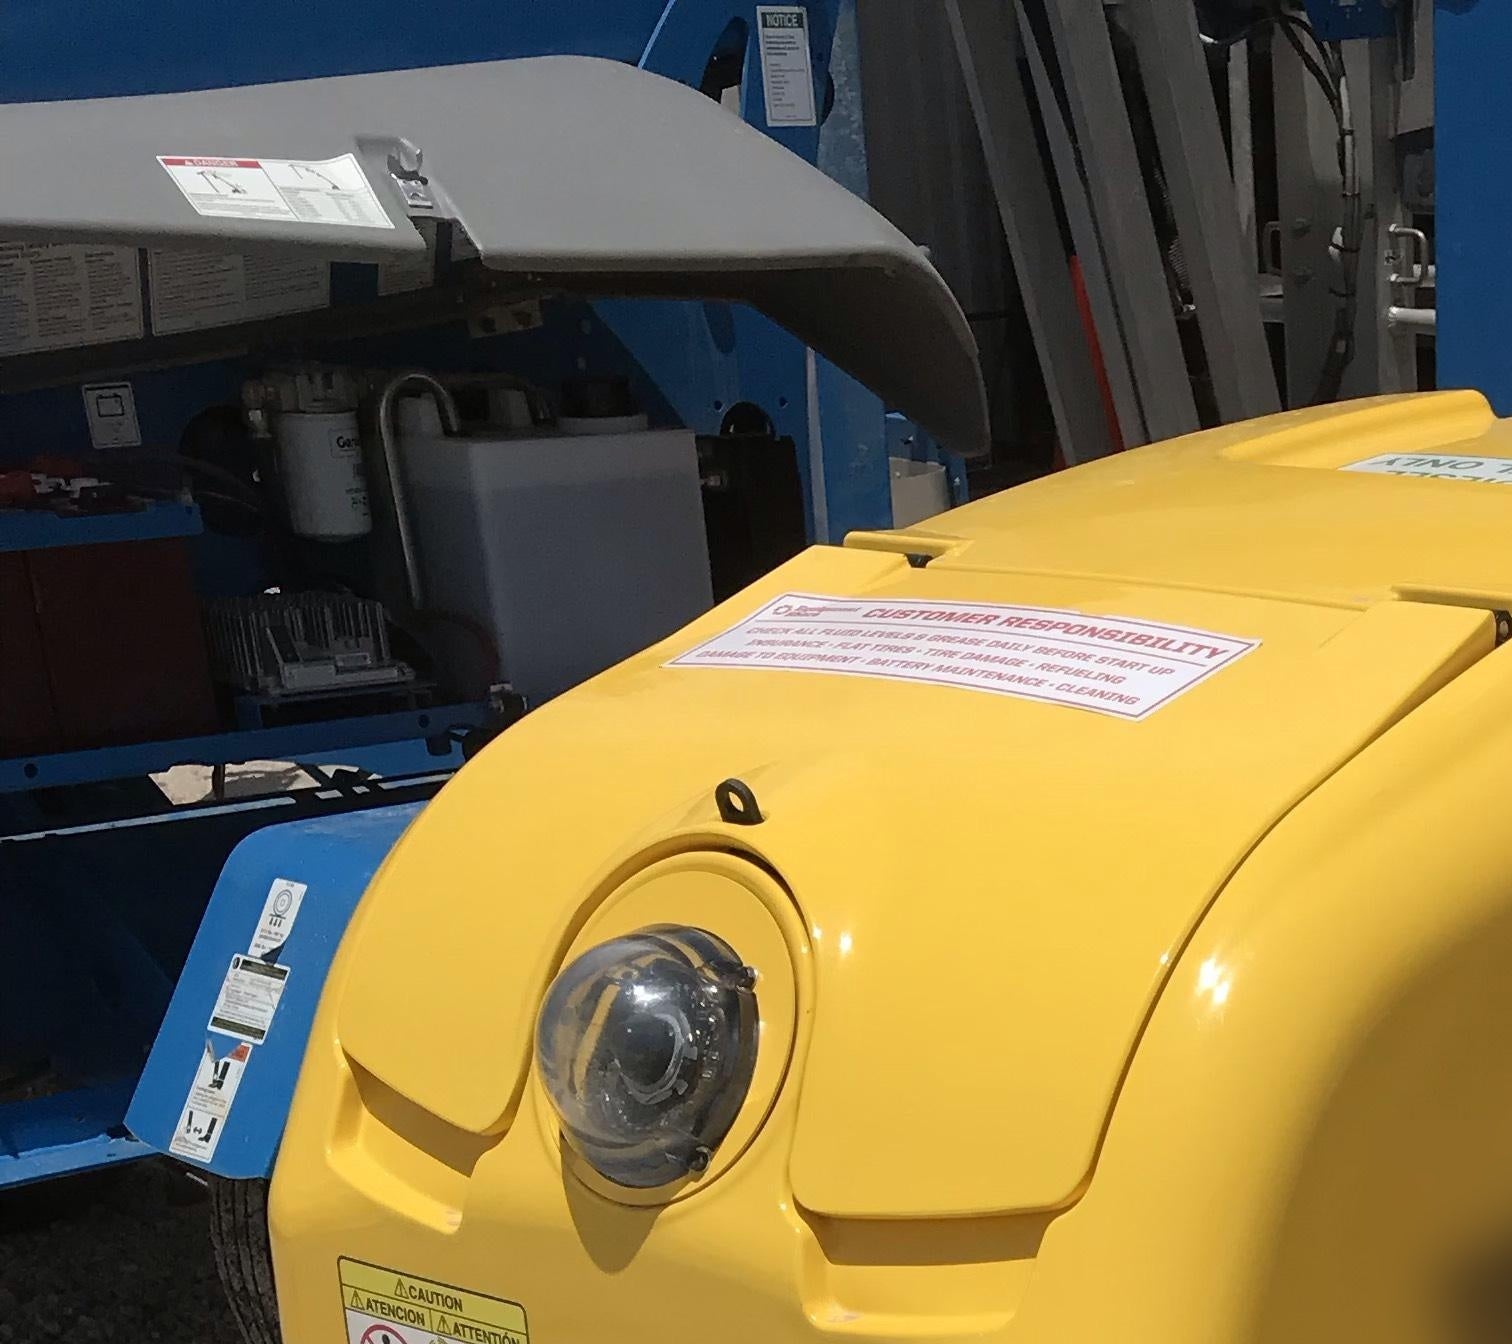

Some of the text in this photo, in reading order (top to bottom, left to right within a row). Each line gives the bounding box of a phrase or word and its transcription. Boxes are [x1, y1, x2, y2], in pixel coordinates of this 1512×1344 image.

[766, 14, 798, 27] NOTICE
[1368, 457, 1484, 470] ONLY
[795, 627, 818, 635] ALL
[860, 630, 915, 640] LEVELS
[926, 634, 988, 646] GREASE
[985, 640, 1034, 652] DAILY
[1032, 646, 1097, 662] BEFORE
[1095, 656, 1151, 672] START
[1148, 665, 1176, 676] UP
[862, 608, 1229, 659] CUSTOMER RESPONSIBILITY
[774, 652, 862, 664] EQUIPMENT
[865, 658, 935, 670] BATTERY
[932, 664, 1049, 687] MAINTENANCE
[1055, 683, 1140, 705] CLEANING
[833, 642, 872, 651] FLAT
[923, 648, 962, 659] TIRE
[960, 652, 1029, 667] DAMAGE
[1034, 662, 1126, 685] REFUELING
[366, 1297, 425, 1326] ATENCION
[408, 1285, 463, 1312] CAUTION
